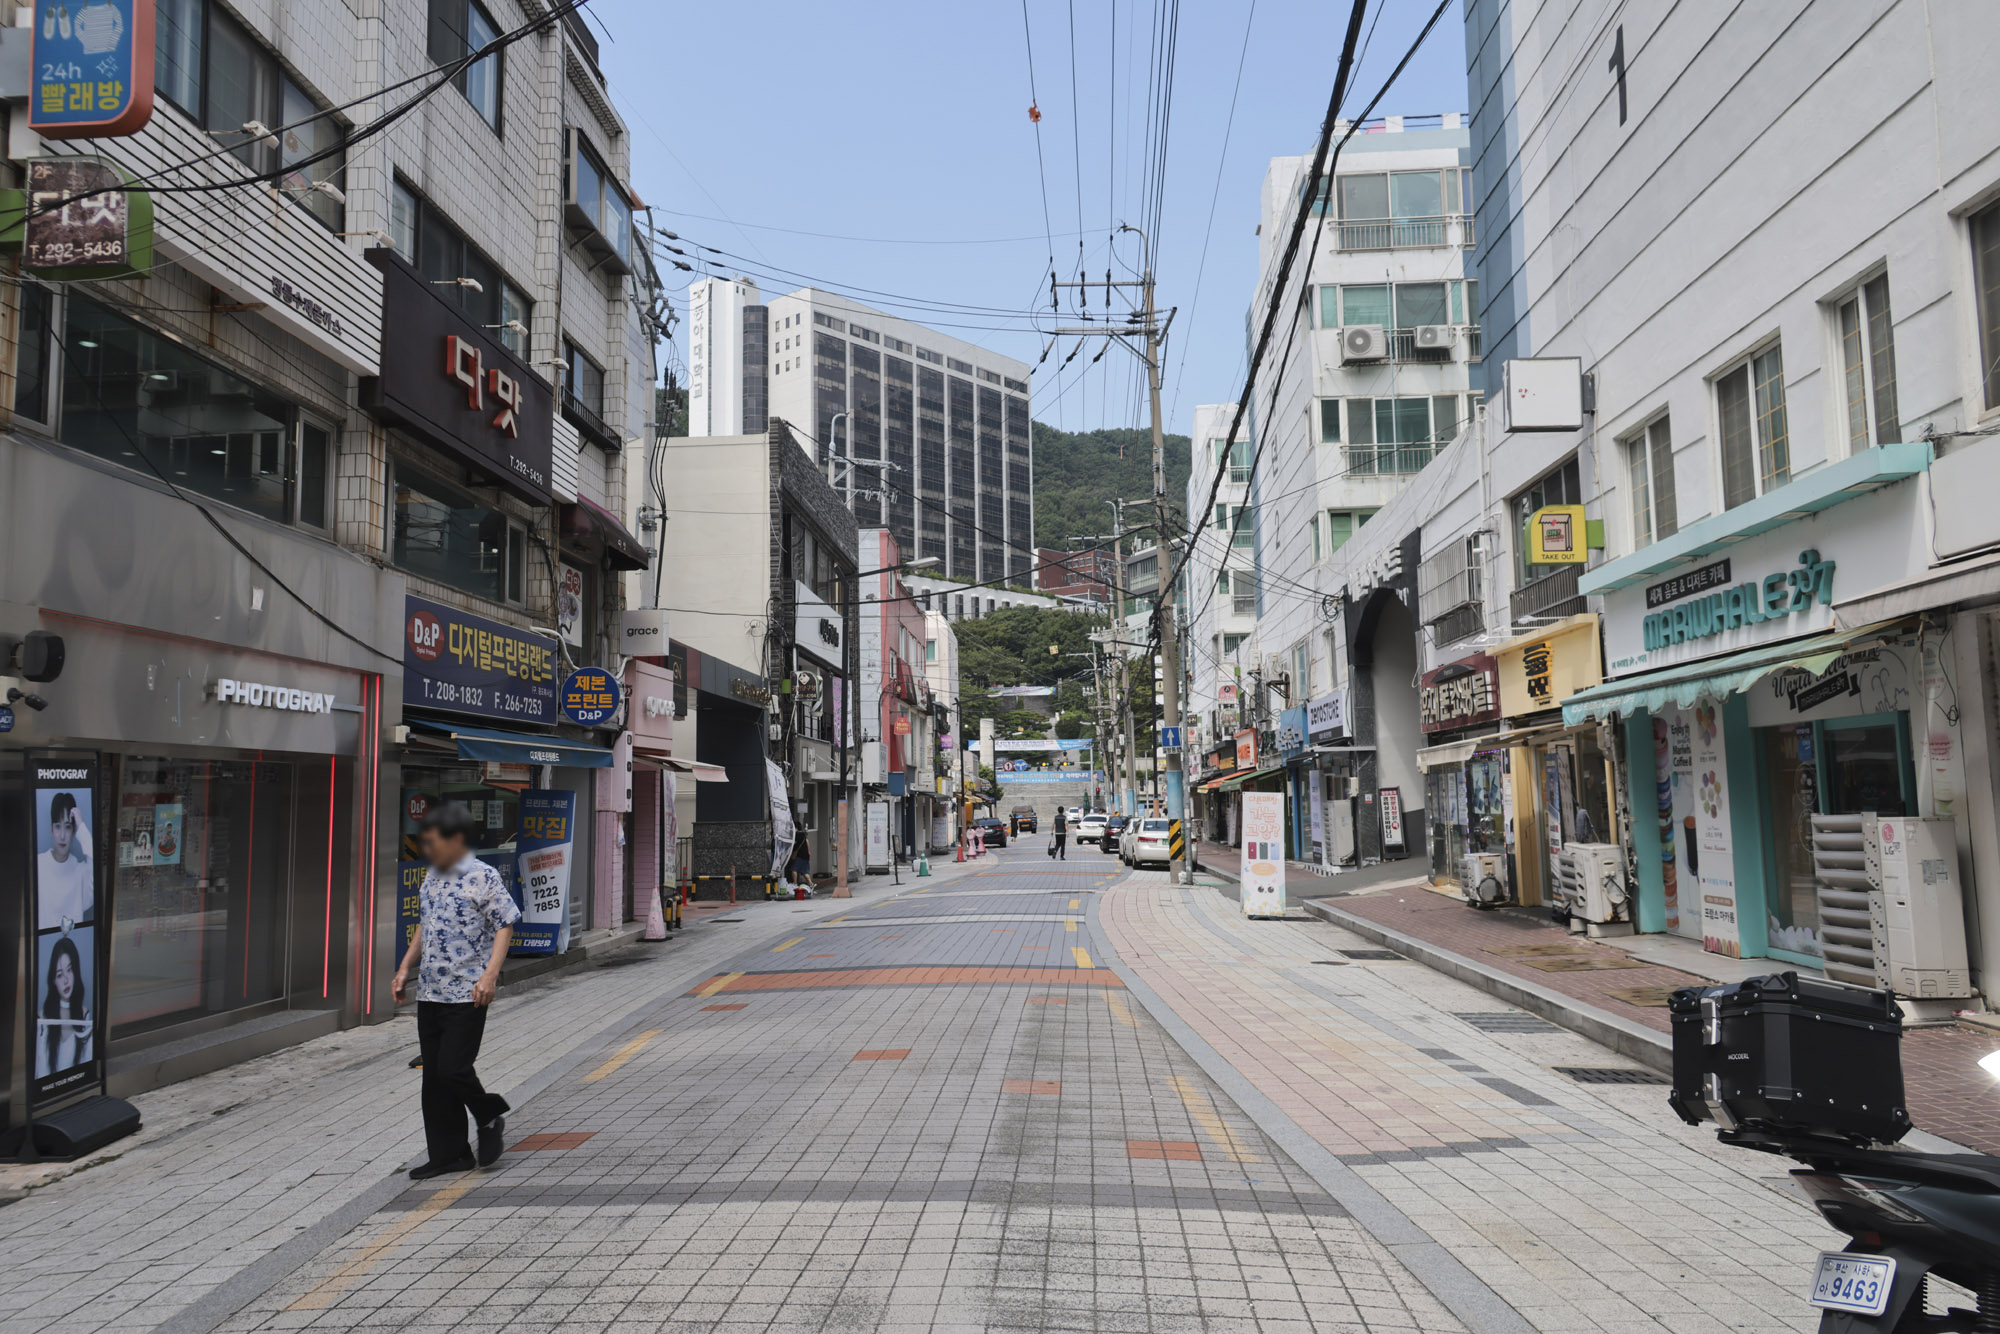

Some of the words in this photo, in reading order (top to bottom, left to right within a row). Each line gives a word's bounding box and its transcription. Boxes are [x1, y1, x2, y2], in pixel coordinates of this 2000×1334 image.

[42, 62, 82, 81] 24h
[1608, 22, 1628, 128] 1
[41, 80, 123, 112] 빨래방
[29, 240, 122, 262] T.292-5436
[509, 454, 544, 486] T.292-5436
[1649, 586, 1663, 604] 세계
[1664, 578, 1679, 600] 음료
[1679, 579, 1686, 593] &
[1687, 569, 1708, 589] 디저트
[1709, 562, 1725, 584] 카페
[414, 617, 440, 648] D&P
[626, 626, 659, 638] grace
[448, 622, 553, 682] 디지털프린팅랜드
[575, 675, 606, 691] 제본
[217, 678, 336, 714] PHOTOGRAY
[436, 680, 483, 707] 208-1832
[504, 693, 542, 716] 266-7253
[567, 693, 614, 709] 프린트
[578, 710, 603, 720] D&P
[37, 768, 89, 779] PHOTOGRAY
[410, 799, 426, 814] D&P
[523, 816, 567, 840] 맛집
[1884, 846, 1895, 855] LG
[530, 875, 548, 887] 010
[533, 886, 559, 900] 7222
[534, 898, 560, 913] 7853
[1704, 907, 1719, 921] 프랑스
[1719, 910, 1735, 924] 마카롱
[1835, 1263, 1849, 1274] 부산
[1853, 1264, 1871, 1277] 사하
[1819, 1282, 1829, 1295] 아
[1831, 1277, 1879, 1303] 9463
